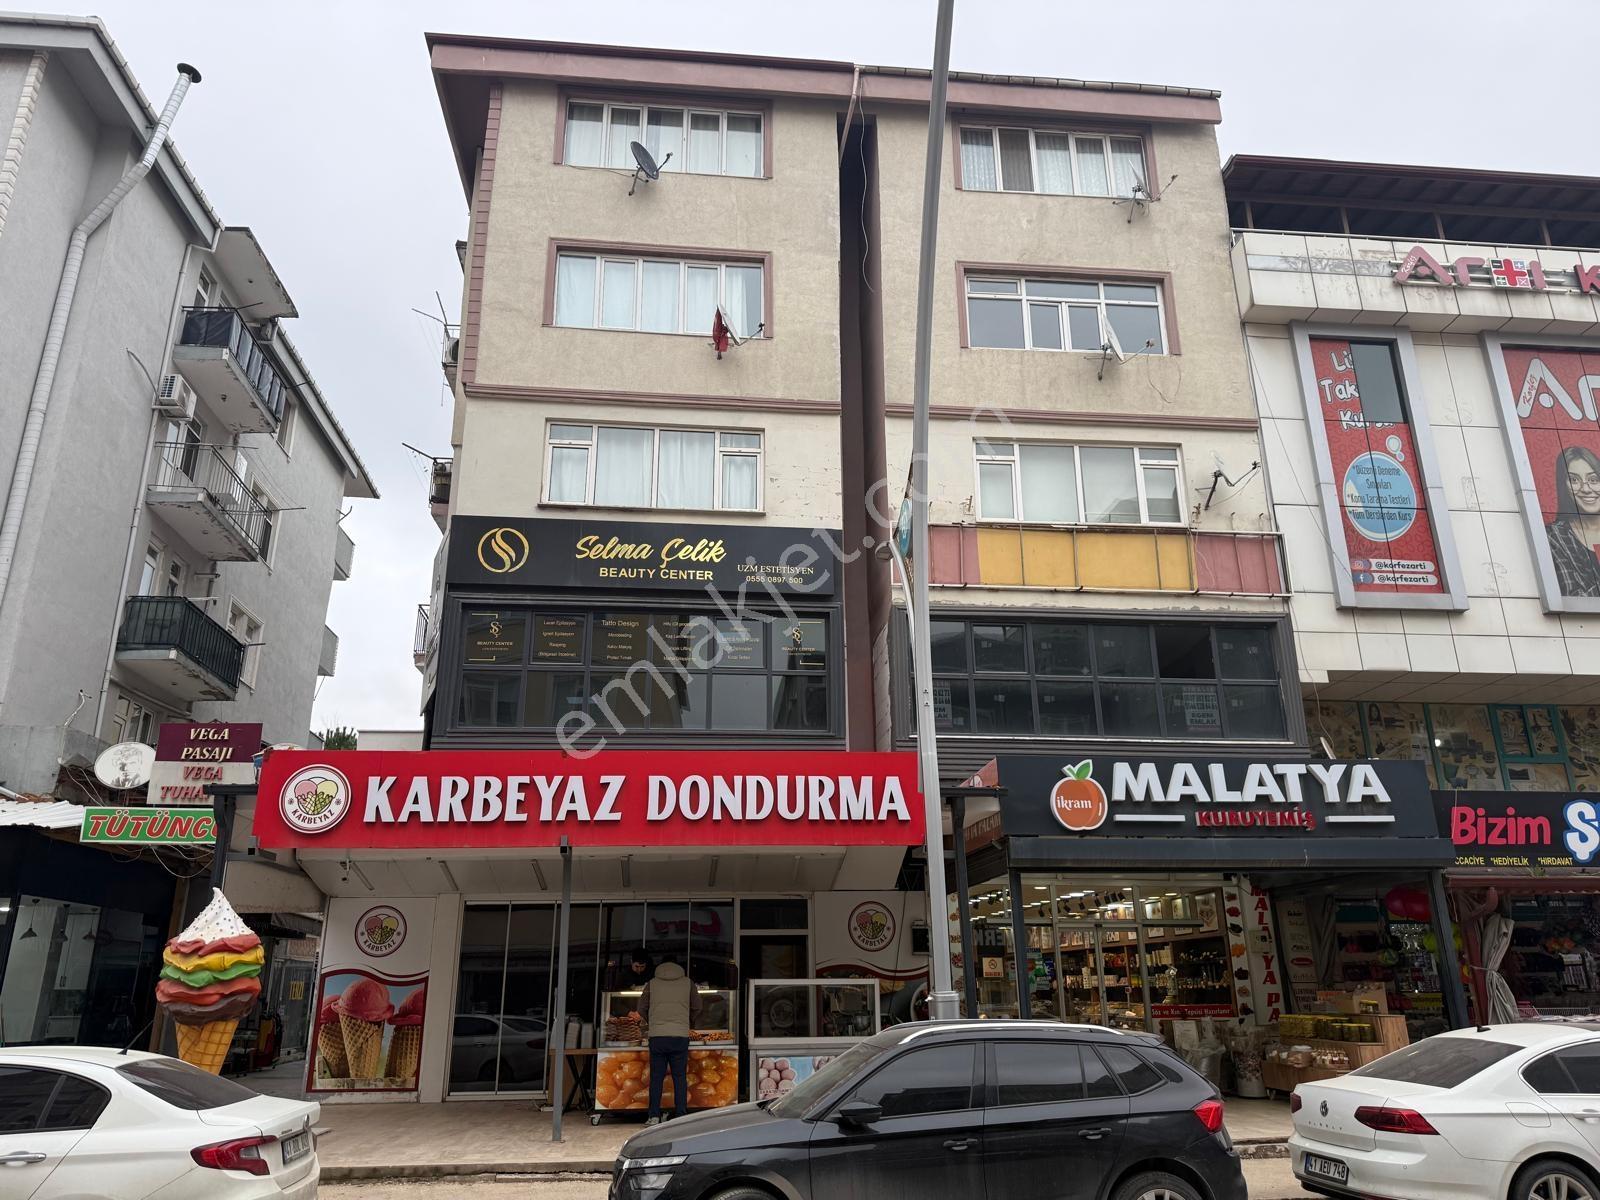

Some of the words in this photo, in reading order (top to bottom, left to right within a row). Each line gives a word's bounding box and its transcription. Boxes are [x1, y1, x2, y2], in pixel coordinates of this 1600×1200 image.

[1389, 494, 1411, 504] Testleri
[1398, 511, 1412, 520] Kurs
[575, 535, 654, 560] Selma
[659, 538, 727, 568] Çelik
[599, 567, 655, 579] BEAUTY
[660, 568, 714, 581] CENTER
[737, 564, 758, 573] UZM
[617, 620, 640, 628] Design
[189, 728, 230, 741] VEGA
[180, 746, 234, 762] PASAJI
[182, 766, 223, 780] VEGA
[1111, 762, 1392, 803] MALATYA
[160, 785, 211, 801] TUHA
[363, 775, 627, 823] KARBEYAZ
[646, 774, 912, 822] DONDURMA
[1056, 795, 1093, 811] ikram
[89, 810, 217, 839] TÜTÜNC
[291, 808, 336, 825] KARBEYAZ
[1195, 806, 1317, 832] KURUYEMİŞ
[1451, 806, 1551, 845] Bizim
[1565, 801, 1600, 861] Ş
[362, 938, 398, 953] KARBEYAZ
[1309, 1160, 1317, 1172] 41
[1319, 1161, 1331, 1175] AEU
[1332, 1163, 1346, 1178] 748
